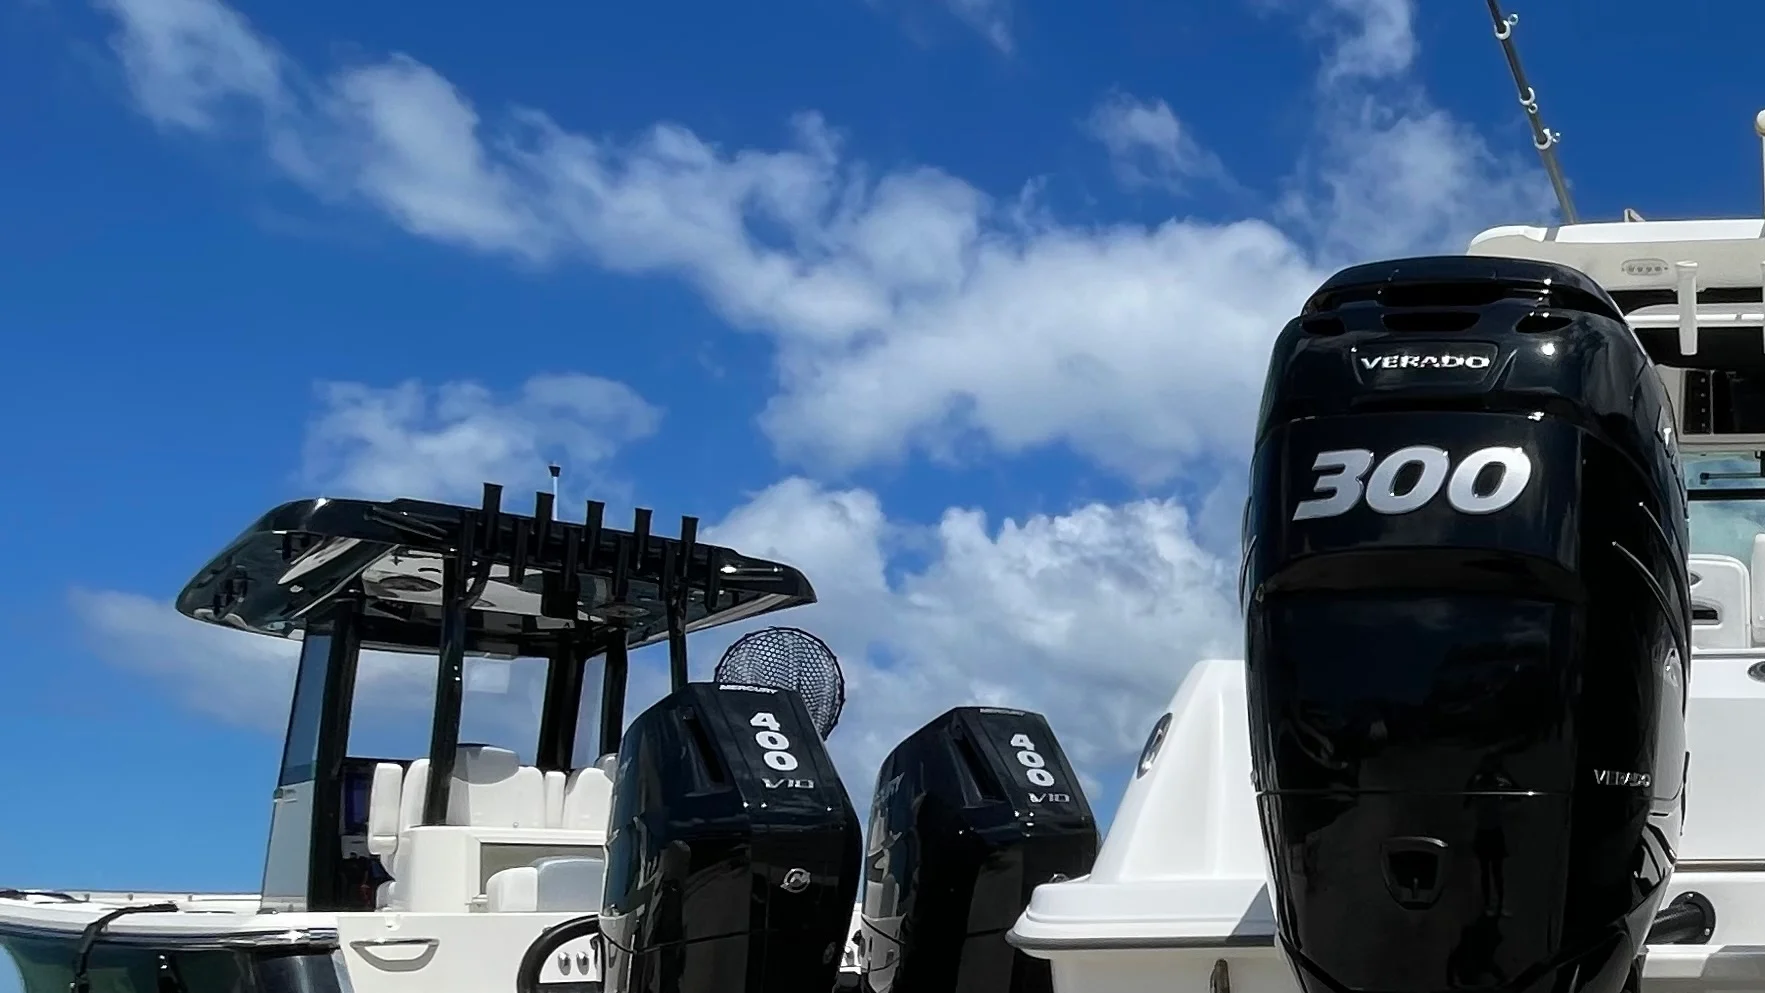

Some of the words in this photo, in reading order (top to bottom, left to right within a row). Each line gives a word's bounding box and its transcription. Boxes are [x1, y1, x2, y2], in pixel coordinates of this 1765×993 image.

[1360, 353, 1490, 371] VERADO
[1292, 445, 1532, 521] 300
[750, 712, 798, 771] 400
[1010, 733, 1055, 787] 400
[761, 778, 815, 789] V10
[1027, 792, 1070, 803] V10
